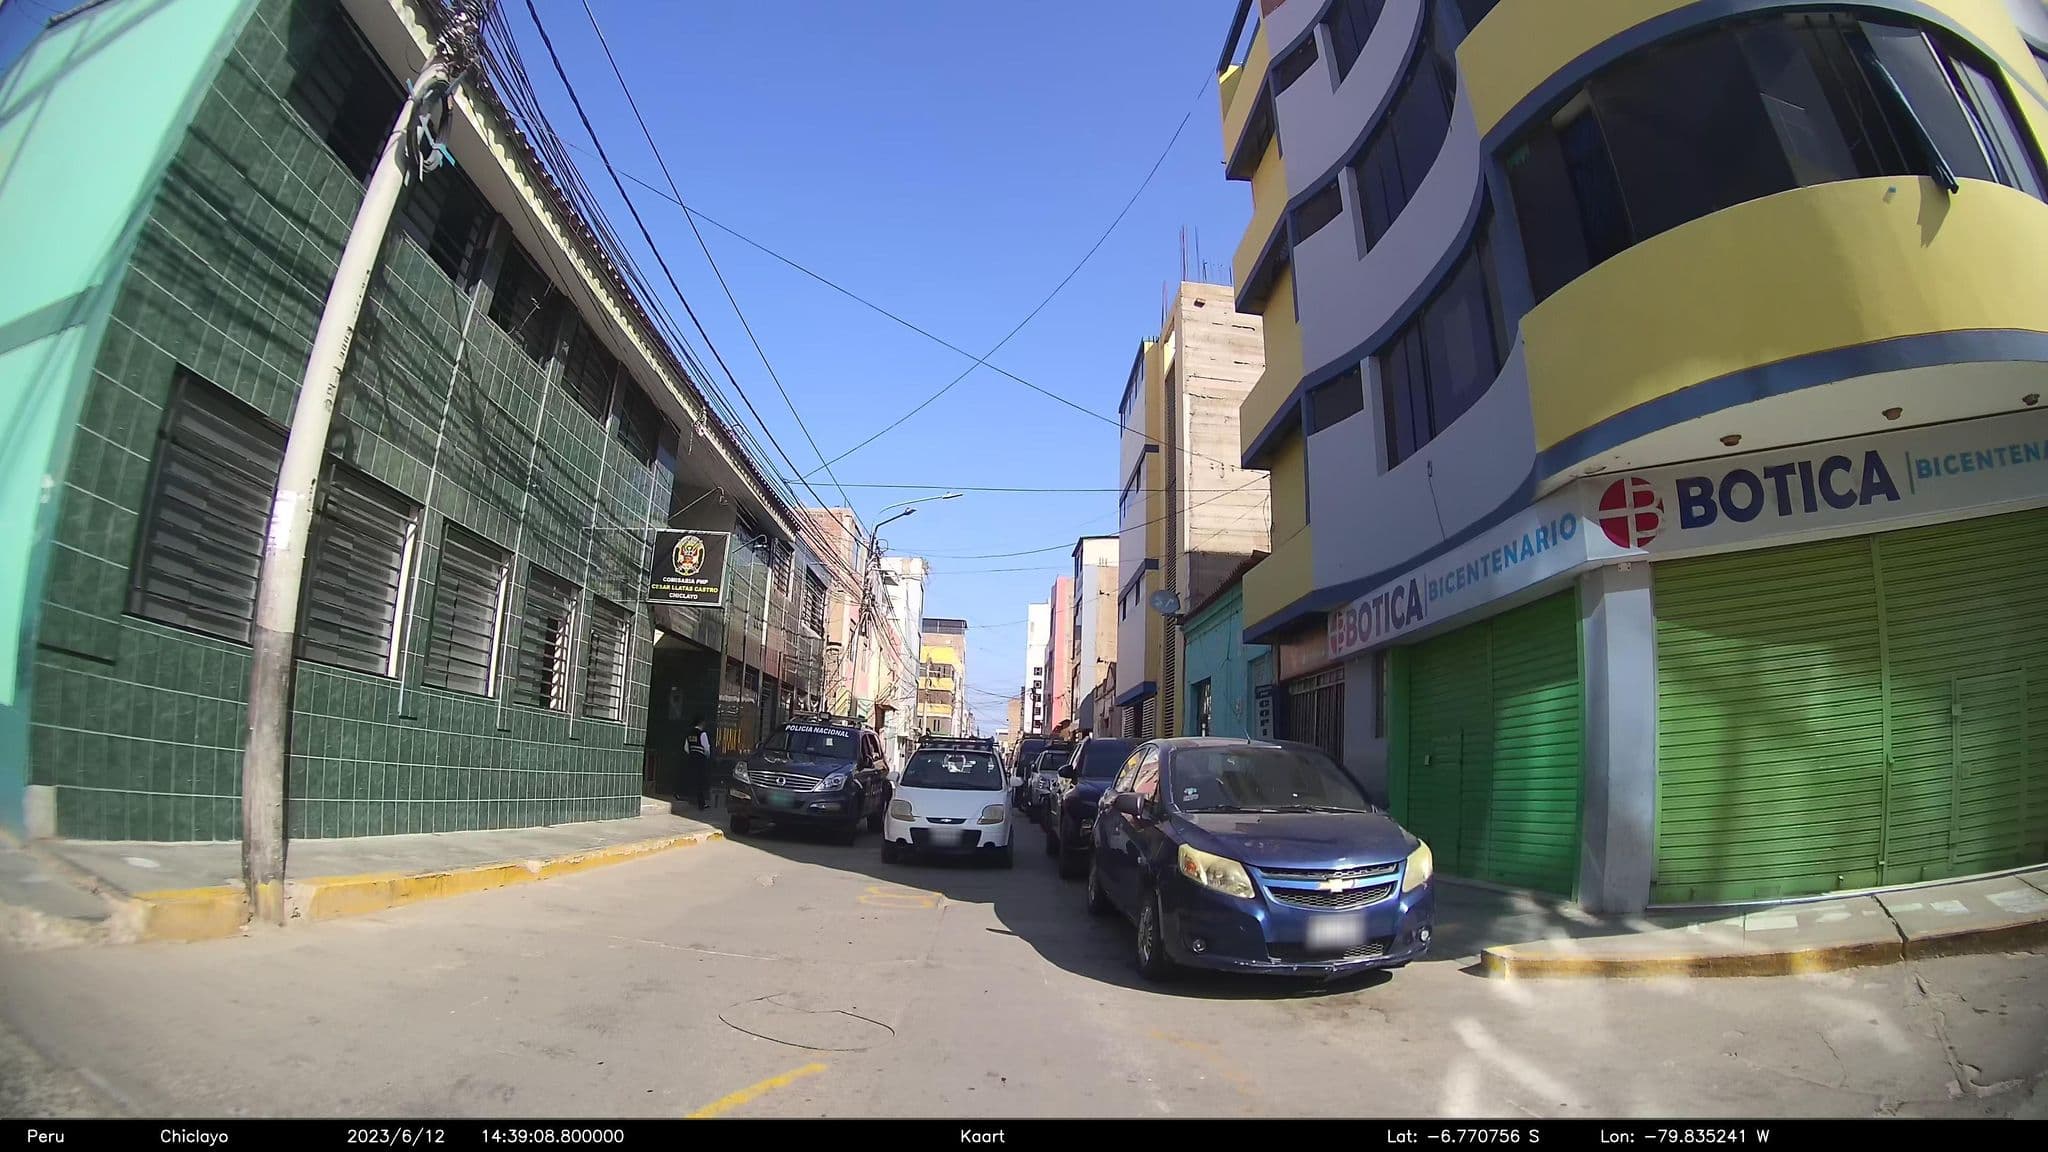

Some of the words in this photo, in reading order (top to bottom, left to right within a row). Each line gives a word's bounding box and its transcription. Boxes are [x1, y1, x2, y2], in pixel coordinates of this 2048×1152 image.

[1676, 449, 1901, 530] BOTICA
[668, 592, 698, 600] CHICLAYO
[1345, 577, 1424, 648] BOTICA
[1428, 511, 1577, 602] BICENTENARIO
[785, 724, 813, 733] POLICIA
[813, 726, 850, 738] NACIONAL
